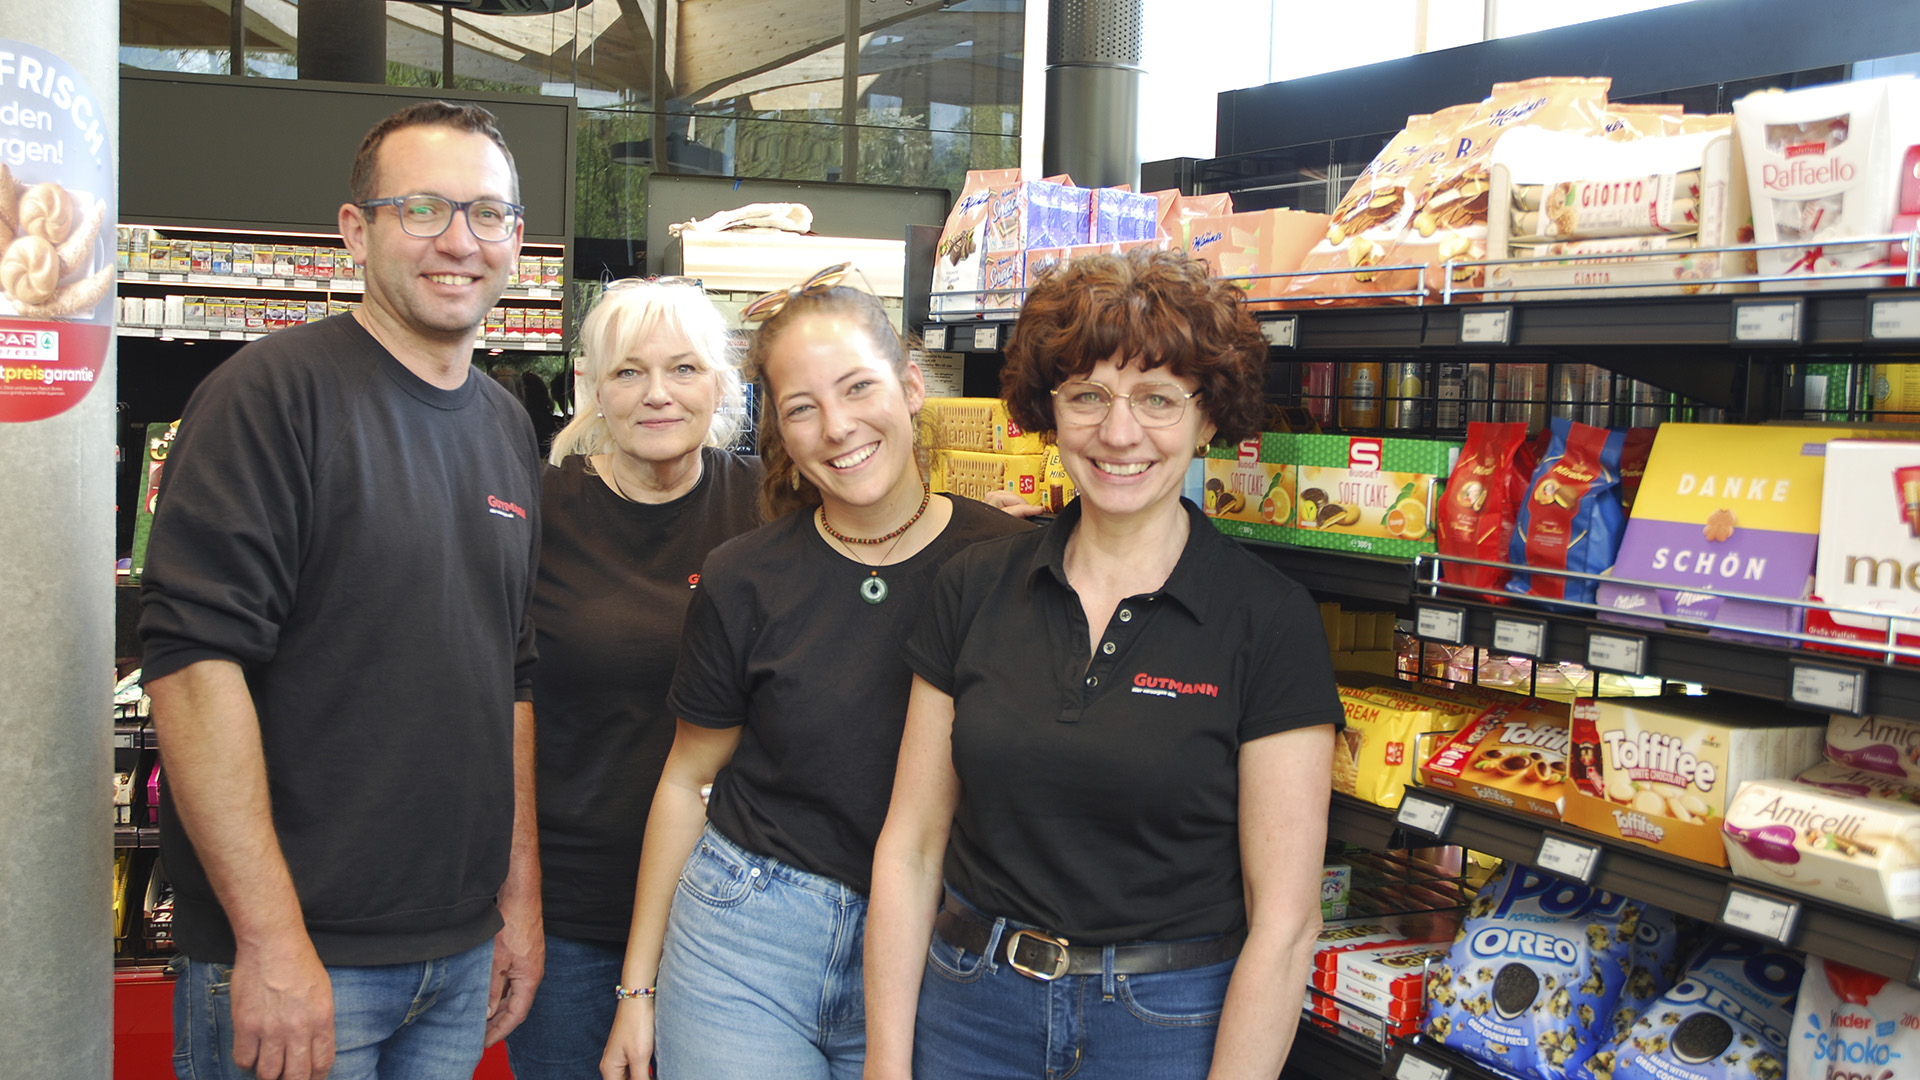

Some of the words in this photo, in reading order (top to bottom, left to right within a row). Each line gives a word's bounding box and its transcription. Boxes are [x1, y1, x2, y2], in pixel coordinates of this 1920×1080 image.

[1763, 158, 1854, 190] Raffaello
[1231, 472, 1246, 494] SOFT
[1248, 474, 1264, 496] CAKE
[1338, 482, 1361, 505] SOFT
[1364, 484, 1389, 508] CAKE
[1677, 474, 1790, 501] DANKE
[1652, 548, 1767, 580] SCHÖN
[1133, 673, 1219, 697] GUTMANN
[1603, 730, 1716, 792] Toffifee
[1629, 768, 1650, 780] WHITE
[1650, 770, 1688, 788] CHOCOLATE
[1753, 796, 1867, 839] Amicelli
[1508, 912, 1561, 924] POPCORN
[1472, 927, 1577, 964] OREO
[1664, 978, 1788, 1048] OREO
[1505, 1035, 1529, 1047] PIECES
[1814, 1032, 1902, 1066] Schoko-
[1635, 1055, 1657, 1074] OREO
[1649, 1054, 1670, 1071] MADE
[1669, 1065, 1690, 1079] WITH
